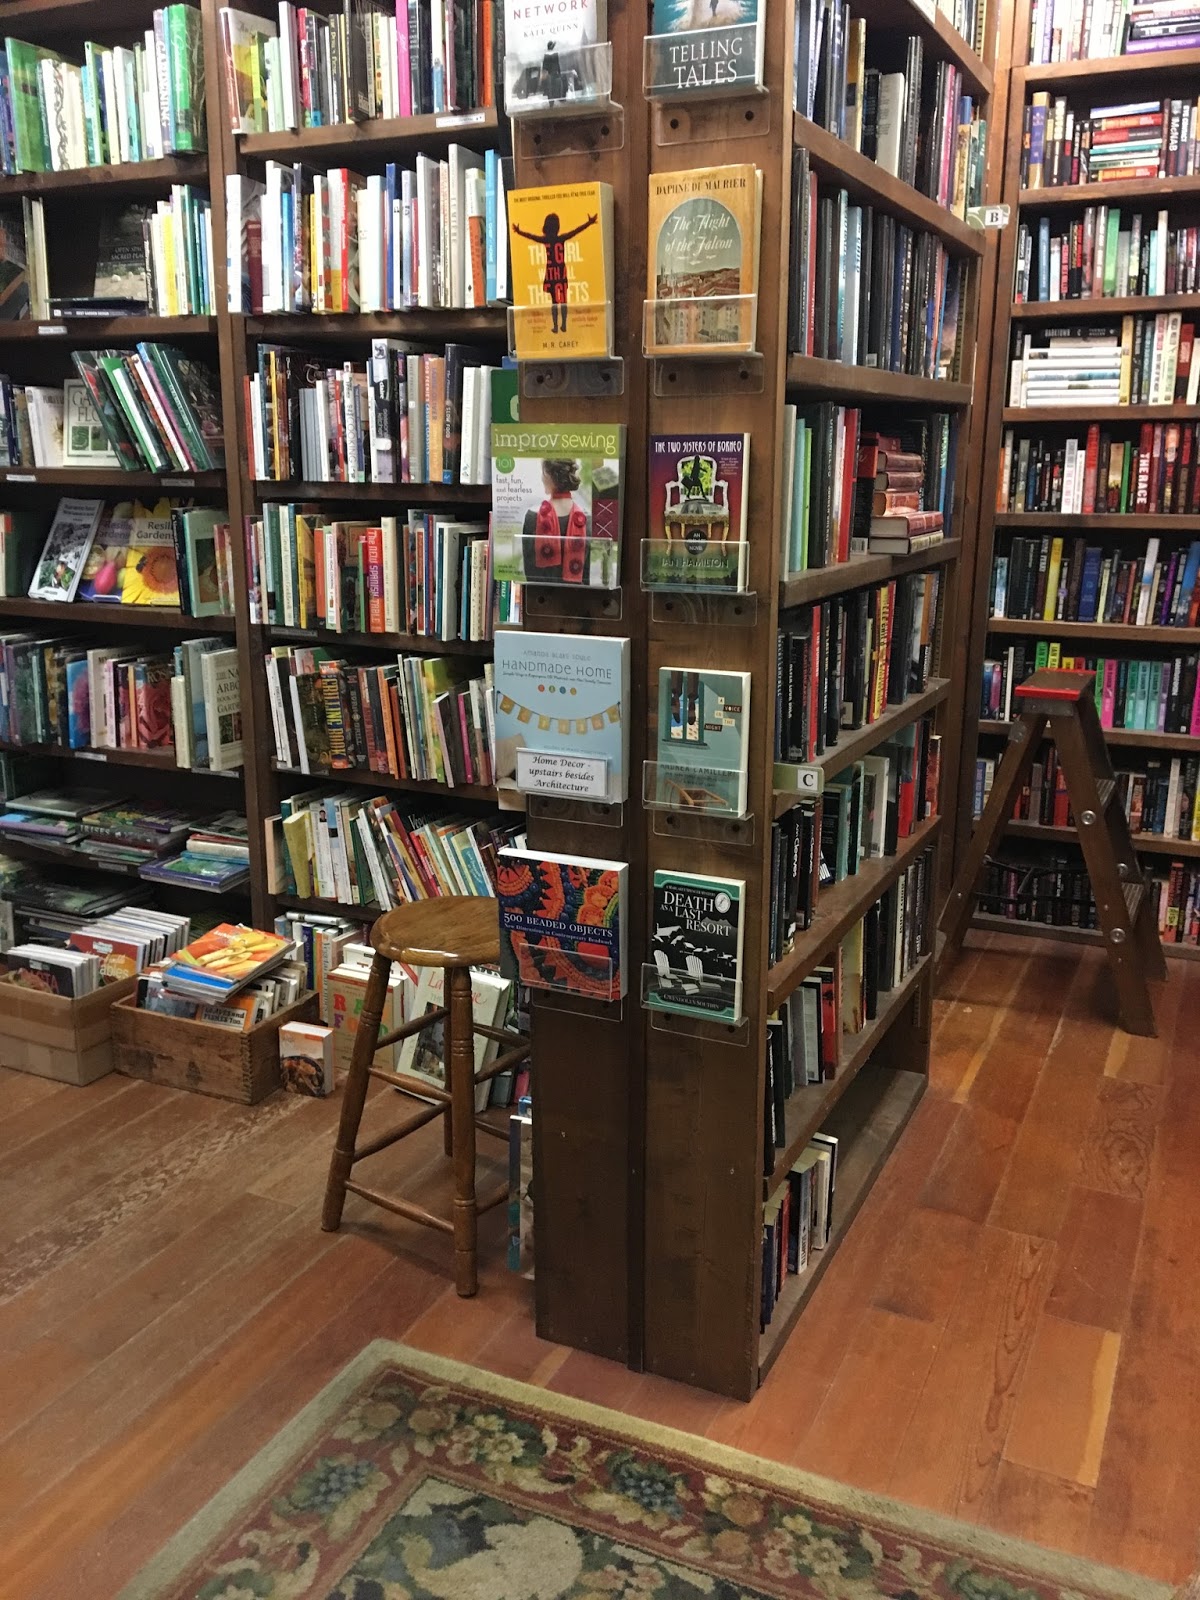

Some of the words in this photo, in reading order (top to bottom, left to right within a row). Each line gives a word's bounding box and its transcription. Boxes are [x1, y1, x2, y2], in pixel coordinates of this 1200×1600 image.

[513, 0, 588, 20] NETWORK
[669, 37, 743, 64] TELLING
[673, 59, 737, 89] TALES
[1169, 117, 1180, 151] McNAB
[656, 183, 690, 195] DAPHNE
[705, 178, 746, 190] MAURIER
[667, 215, 691, 236] The
[692, 213, 731, 235] Flight
[990, 211, 1000, 224] B
[528, 243, 552, 266] THE
[554, 241, 583, 264] GIRL
[665, 239, 676, 254] of
[676, 237, 692, 252] the
[692, 235, 733, 256] Falcon
[538, 266, 560, 281] WITH
[564, 266, 576, 280] ALL
[528, 283, 552, 305] THE
[554, 281, 590, 304] GIFTS
[494, 428, 559, 452] improv
[561, 432, 617, 455] sewing
[655, 441, 666, 453] THE
[667, 441, 681, 453] TWO
[682, 441, 707, 453] SISTERS
[708, 441, 716, 452] OF
[717, 440, 742, 453] BORNEO
[1139, 452, 1151, 473] THE
[507, 483, 533, 494] fearless
[1136, 475, 1149, 504] RACE
[496, 494, 523, 504] projects
[147, 521, 173, 530] Resil
[368, 530, 377, 545] The
[368, 545, 379, 565] NEW
[662, 557, 679, 567] IAN
[682, 557, 729, 569] HAMILTON
[1038, 555, 1048, 572] PERRY
[369, 565, 380, 597] SPANISH
[370, 598, 380, 623] TABLE
[1038, 646, 1047, 656] IAN
[1050, 646, 1058, 656] IAN
[216, 681, 240, 694] ARBO
[322, 678, 343, 726] GRILLING
[327, 728, 347, 757] BOOK
[354, 722, 363, 746] GRILL
[532, 756, 557, 766] Home
[560, 759, 586, 769] Decor
[529, 768, 563, 777] upstairs
[565, 770, 595, 781] besides
[802, 774, 814, 787] C
[534, 779, 589, 792] Architecture
[792, 838, 800, 878] Cleeves
[664, 891, 714, 912] DEATH
[675, 906, 703, 920] LAST
[504, 913, 523, 924] 500
[526, 916, 567, 930] BEADED
[569, 924, 613, 938] OBJECTS
[516, 925, 545, 934] Dimensions
[551, 931, 587, 941] Contemporary
[588, 937, 613, 945] Beadwork
[686, 920, 732, 937] RESORT
